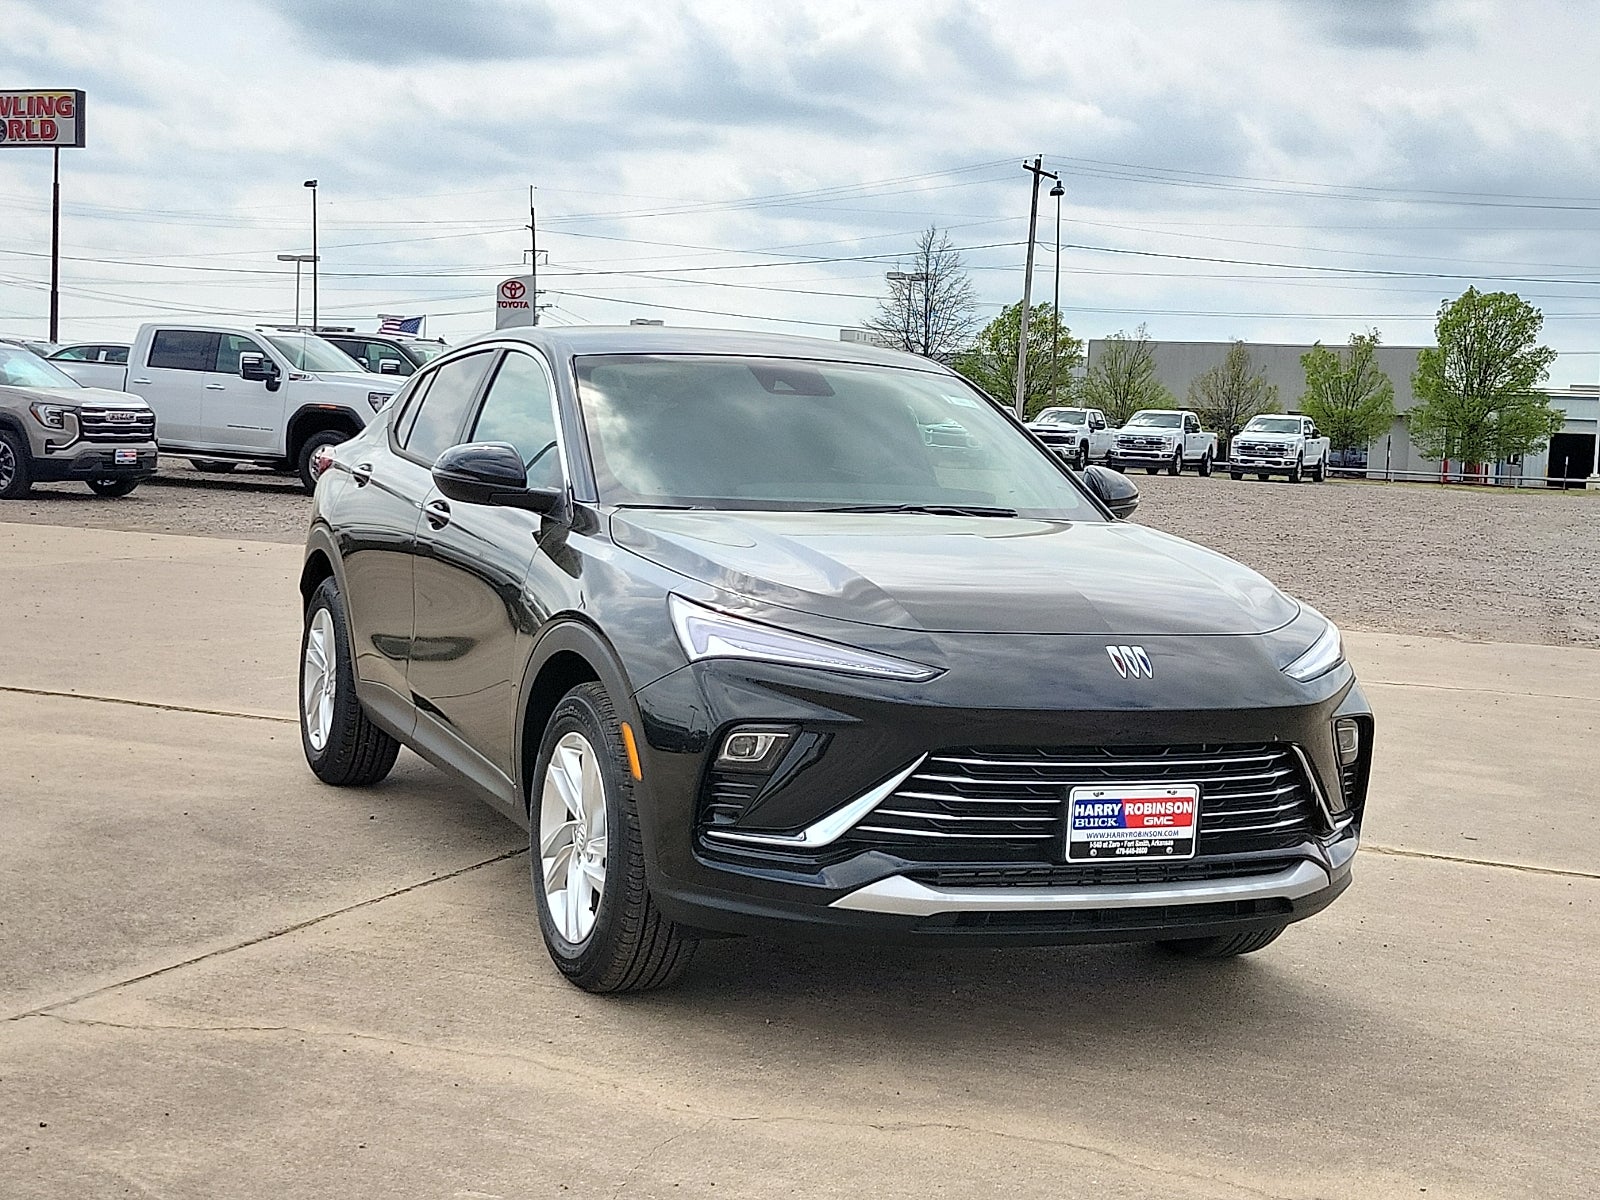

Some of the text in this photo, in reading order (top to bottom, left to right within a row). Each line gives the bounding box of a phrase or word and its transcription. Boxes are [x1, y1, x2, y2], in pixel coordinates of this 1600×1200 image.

[497, 300, 529, 309] TOYOTA
[1074, 801, 1193, 817] HARRY ROBINSON
[1074, 815, 1175, 828] BUICK GMC
[1086, 830, 1179, 839] WWW.HARRYROBINSON.COM
[1124, 840, 1134, 848] Fort
[1151, 839, 1174, 847] Arkansas
